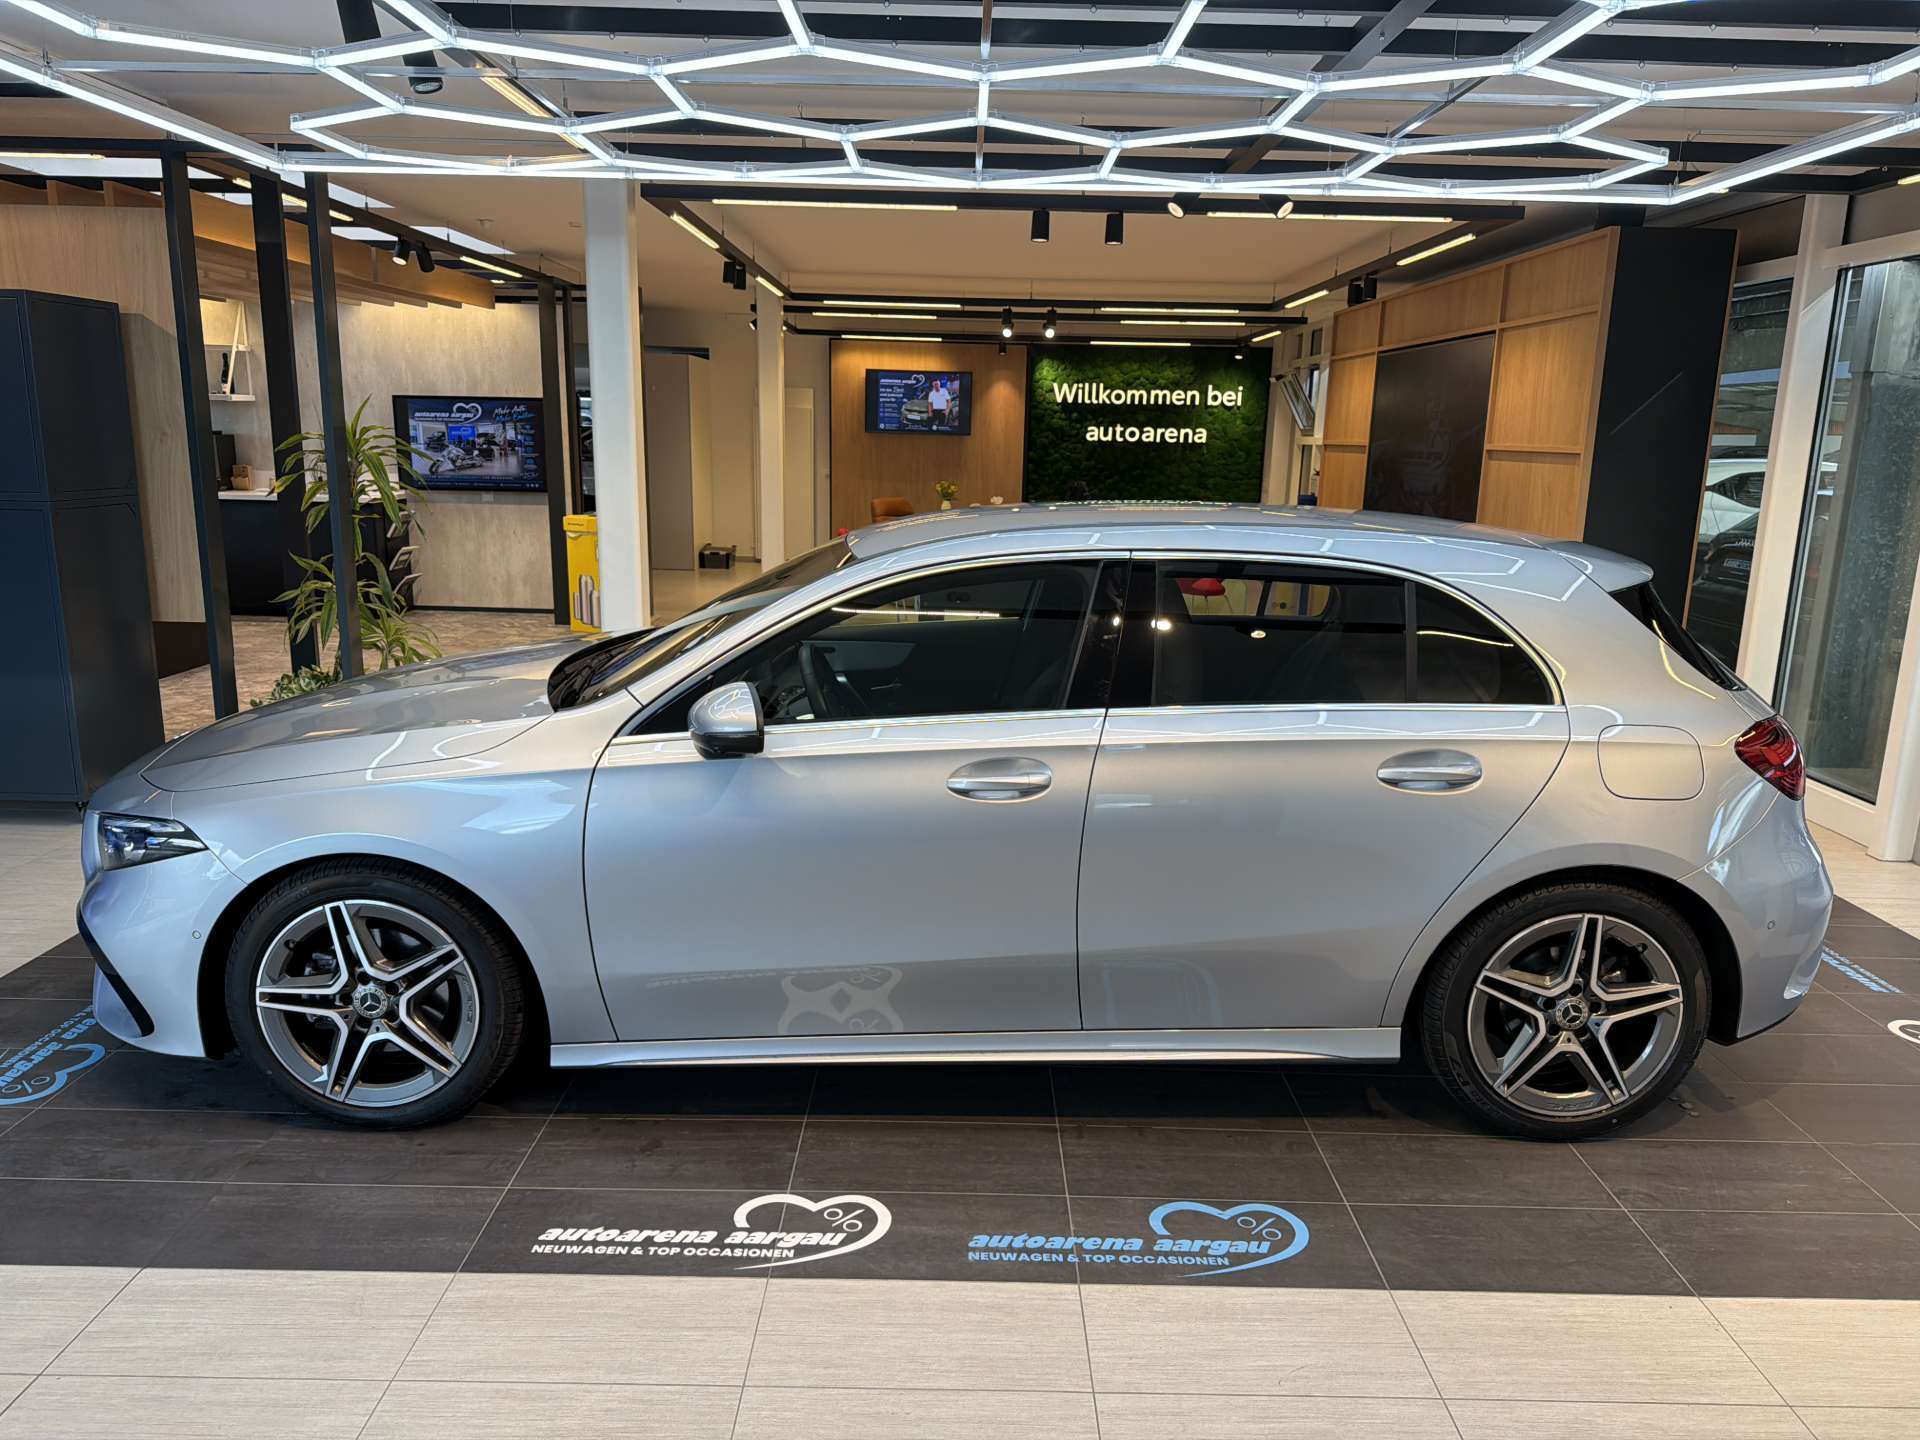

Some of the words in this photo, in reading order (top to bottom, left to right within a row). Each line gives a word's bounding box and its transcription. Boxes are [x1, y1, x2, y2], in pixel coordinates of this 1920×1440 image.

[1053, 382, 1200, 406] Willkommen
[1207, 385, 1244, 407] bei
[1086, 423, 1208, 444] autoarena
[538, 1226, 720, 1244] autoarena
[724, 1228, 848, 1247] aargau
[968, 1232, 1144, 1250] autoarena
[1153, 1236, 1271, 1255] aargau
[531, 1244, 627, 1256] NEUWAGEN
[631, 1245, 644, 1256] &
[648, 1246, 681, 1257] TOP
[685, 1247, 795, 1258] OCCASIONEN
[968, 1251, 1064, 1263] NEUWAGEN
[1066, 1253, 1080, 1263] &
[1082, 1253, 1115, 1264] TOP
[1121, 1255, 1230, 1266] OCCASIONEN
